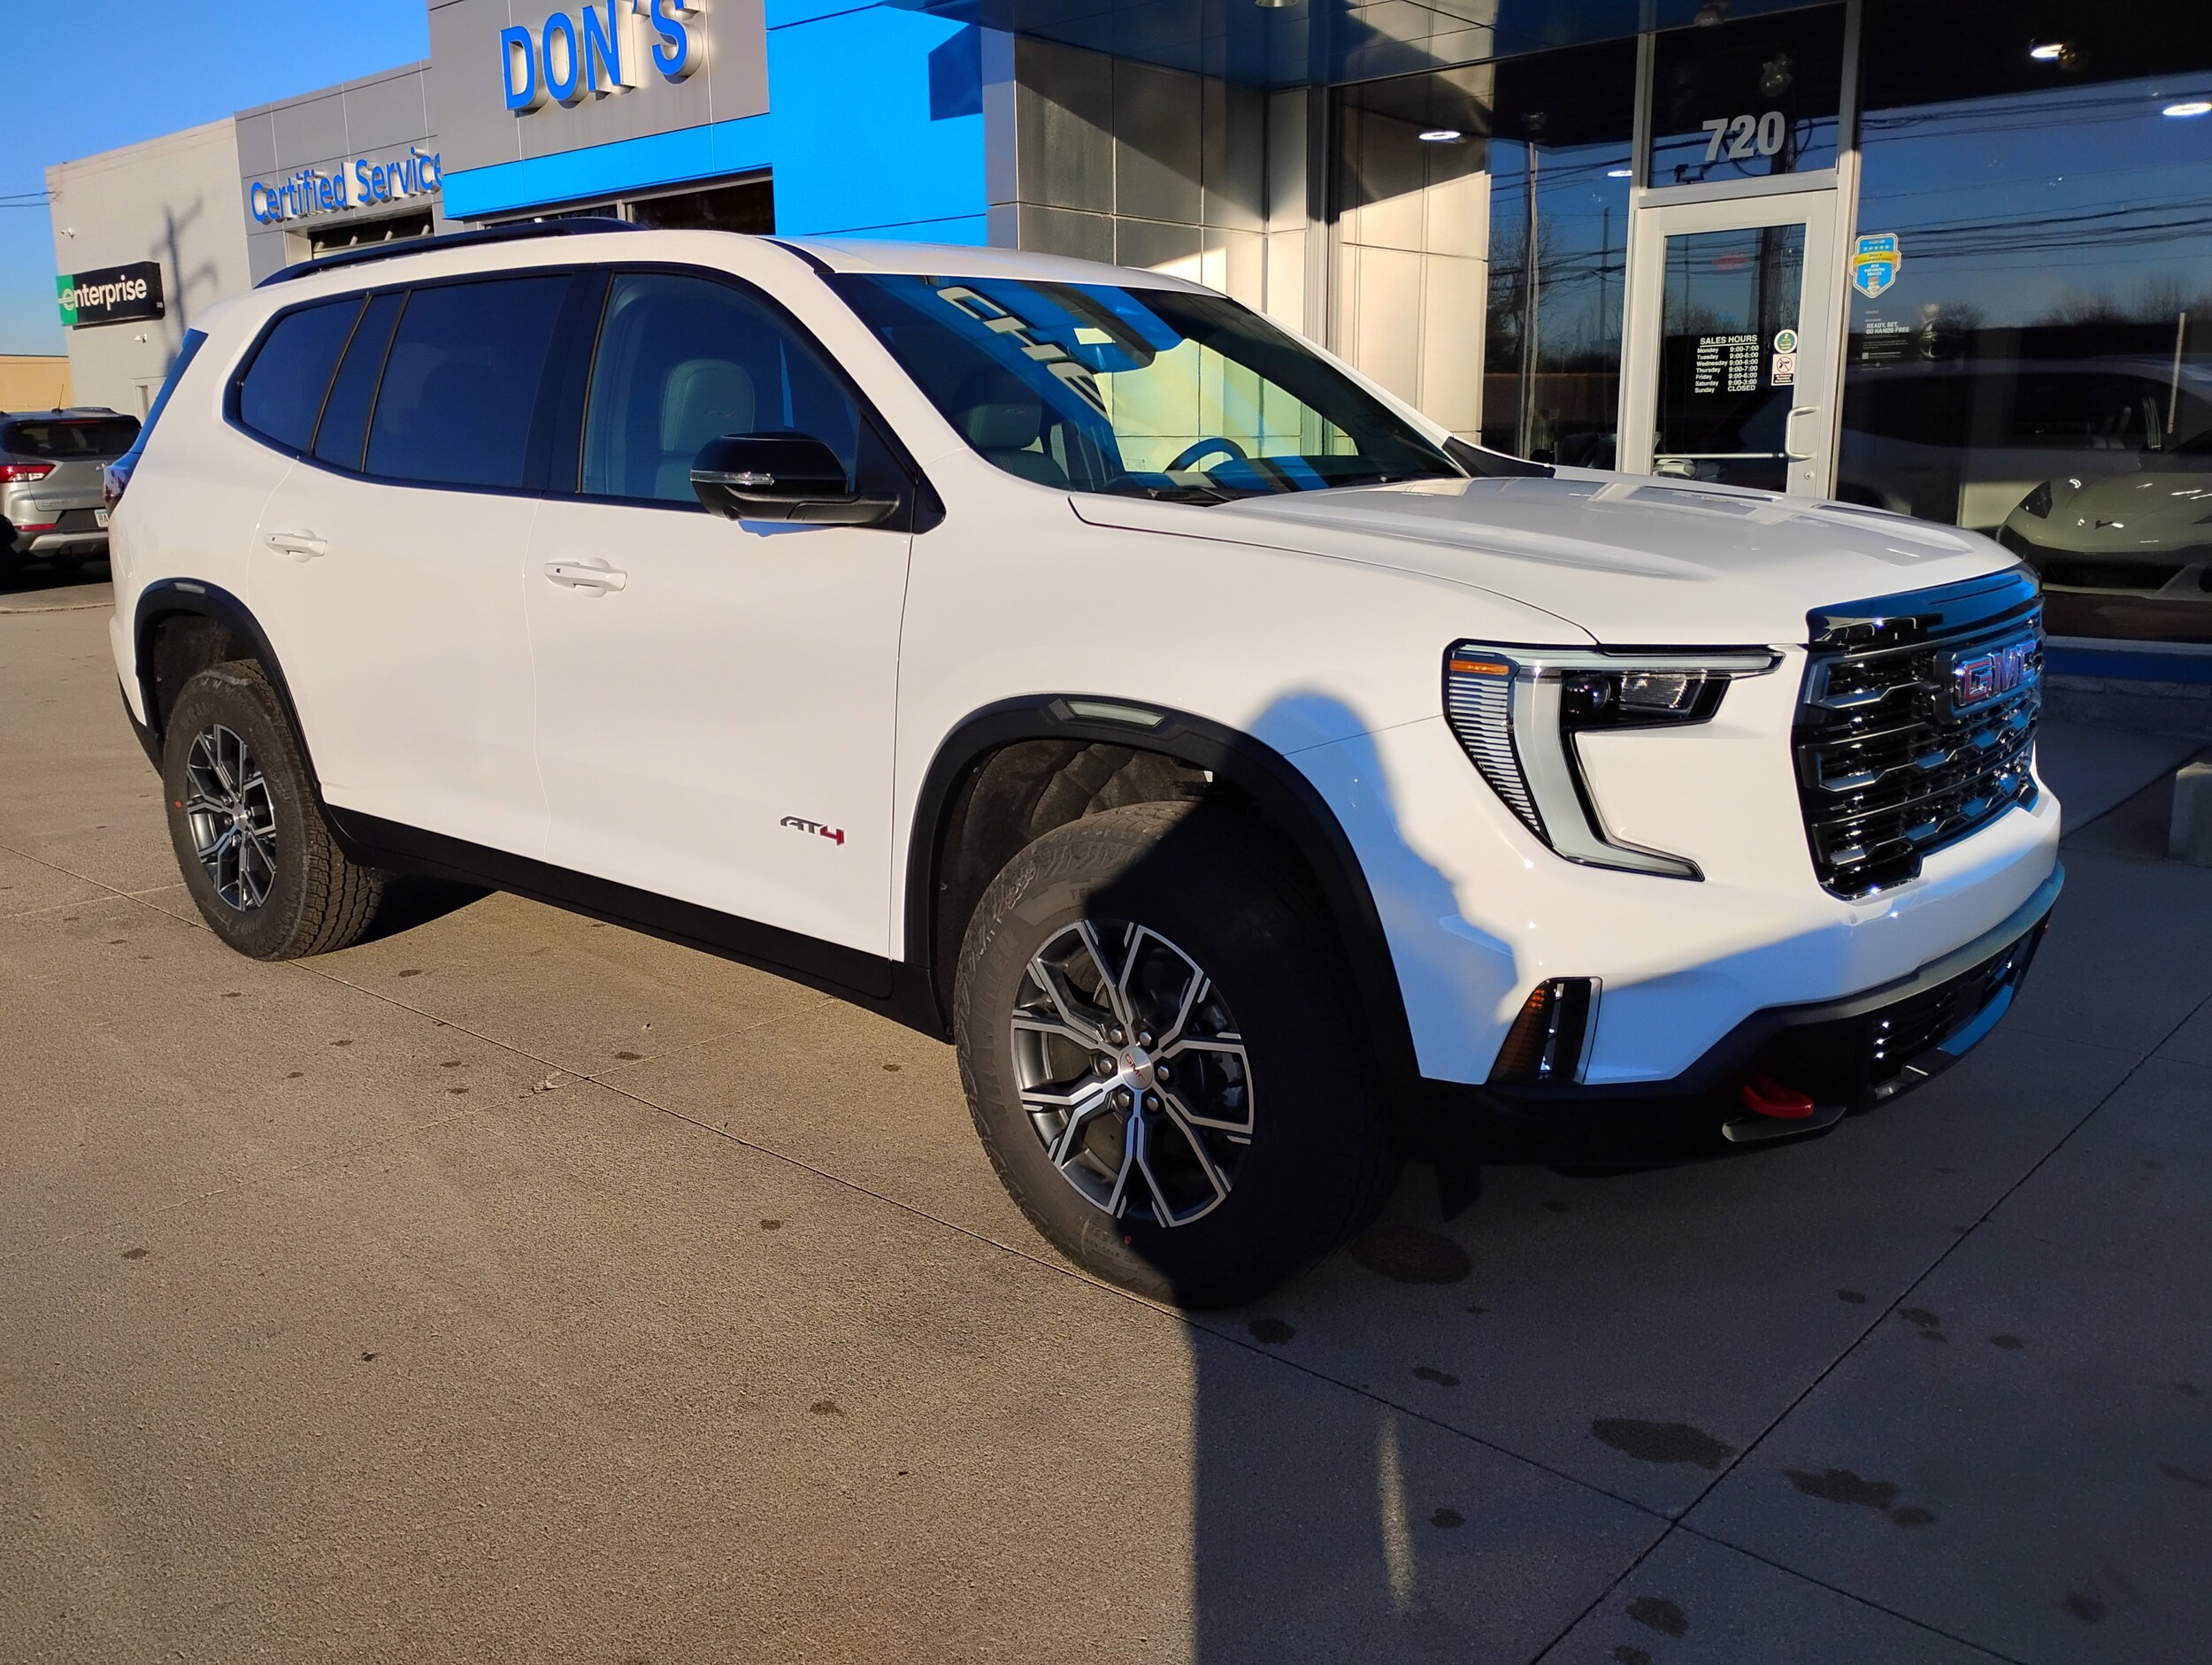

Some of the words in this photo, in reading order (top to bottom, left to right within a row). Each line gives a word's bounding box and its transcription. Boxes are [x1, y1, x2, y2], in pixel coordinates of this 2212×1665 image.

[500, 0, 687, 111] DON'S
[1701, 111, 1786, 161] 720
[250, 161, 348, 222] Certified
[355, 146, 442, 203] Service
[58, 274, 147, 311] enterprise
[1700, 336, 1726, 345] SALES
[1728, 334, 1758, 343] HOURS
[1963, 639, 2037, 702] GMC
[780, 816, 845, 847] AT4
[1125, 1053, 1148, 1084] GMC
